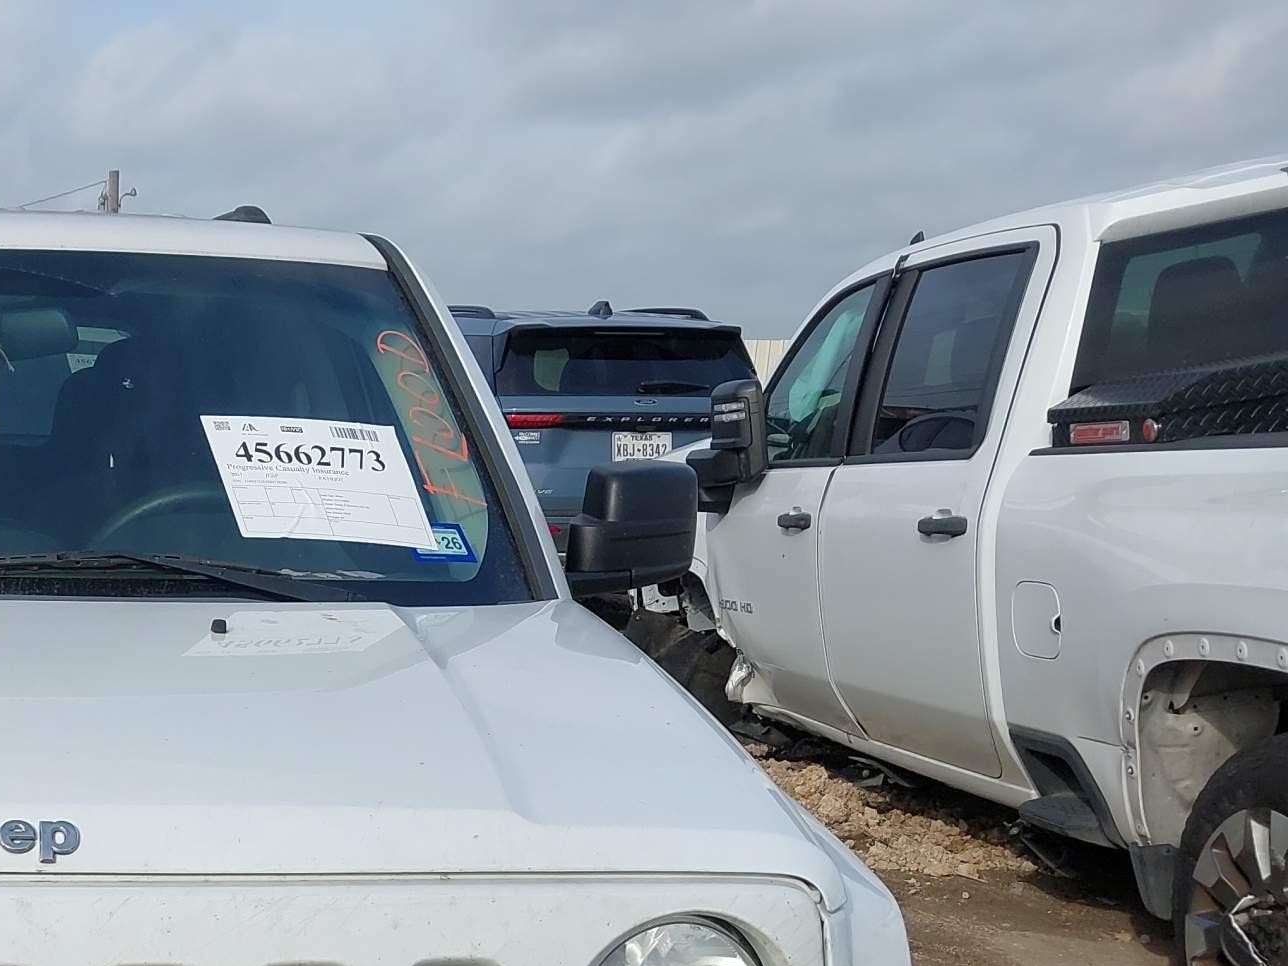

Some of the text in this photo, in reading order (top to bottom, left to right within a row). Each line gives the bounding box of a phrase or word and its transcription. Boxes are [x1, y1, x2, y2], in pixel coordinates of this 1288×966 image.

[235, 440, 386, 472] 45662773
[226, 463, 350, 476] Progressive Casualty Insurance
